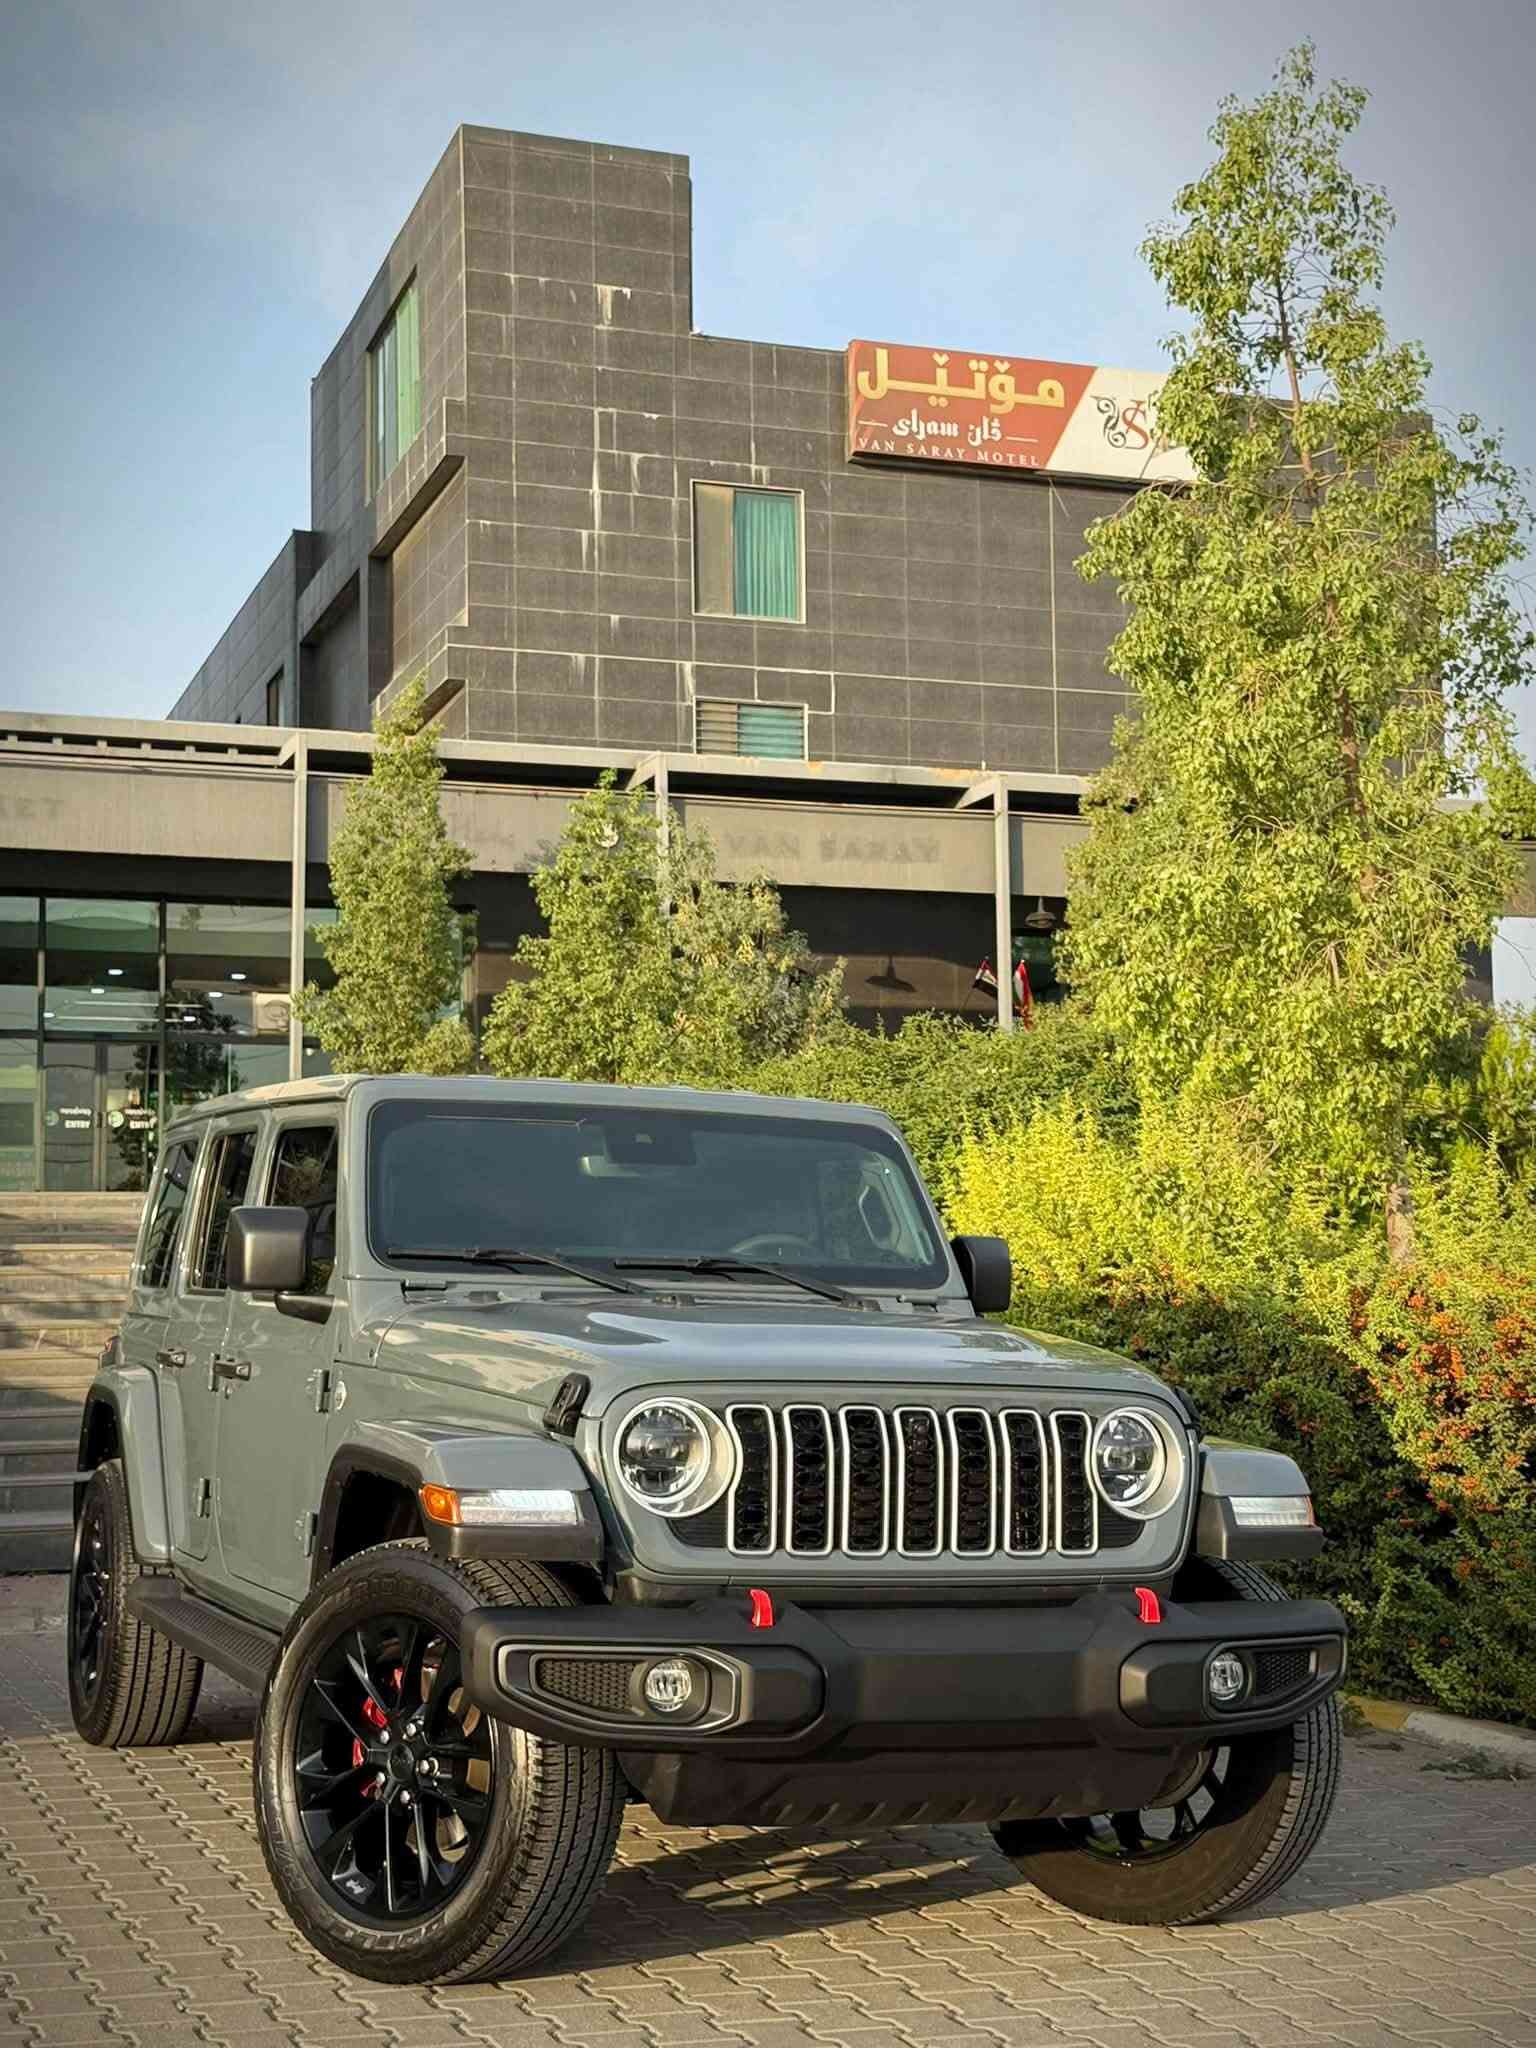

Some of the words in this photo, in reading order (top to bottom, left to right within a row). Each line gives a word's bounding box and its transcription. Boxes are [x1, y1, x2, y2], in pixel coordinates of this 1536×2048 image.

[858, 437, 895, 452] VAN
[906, 442, 967, 460] SARAY
[976, 450, 1040, 466] MOTEL
[724, 832, 800, 858] VAN
[819, 831, 942, 863] SARAY
